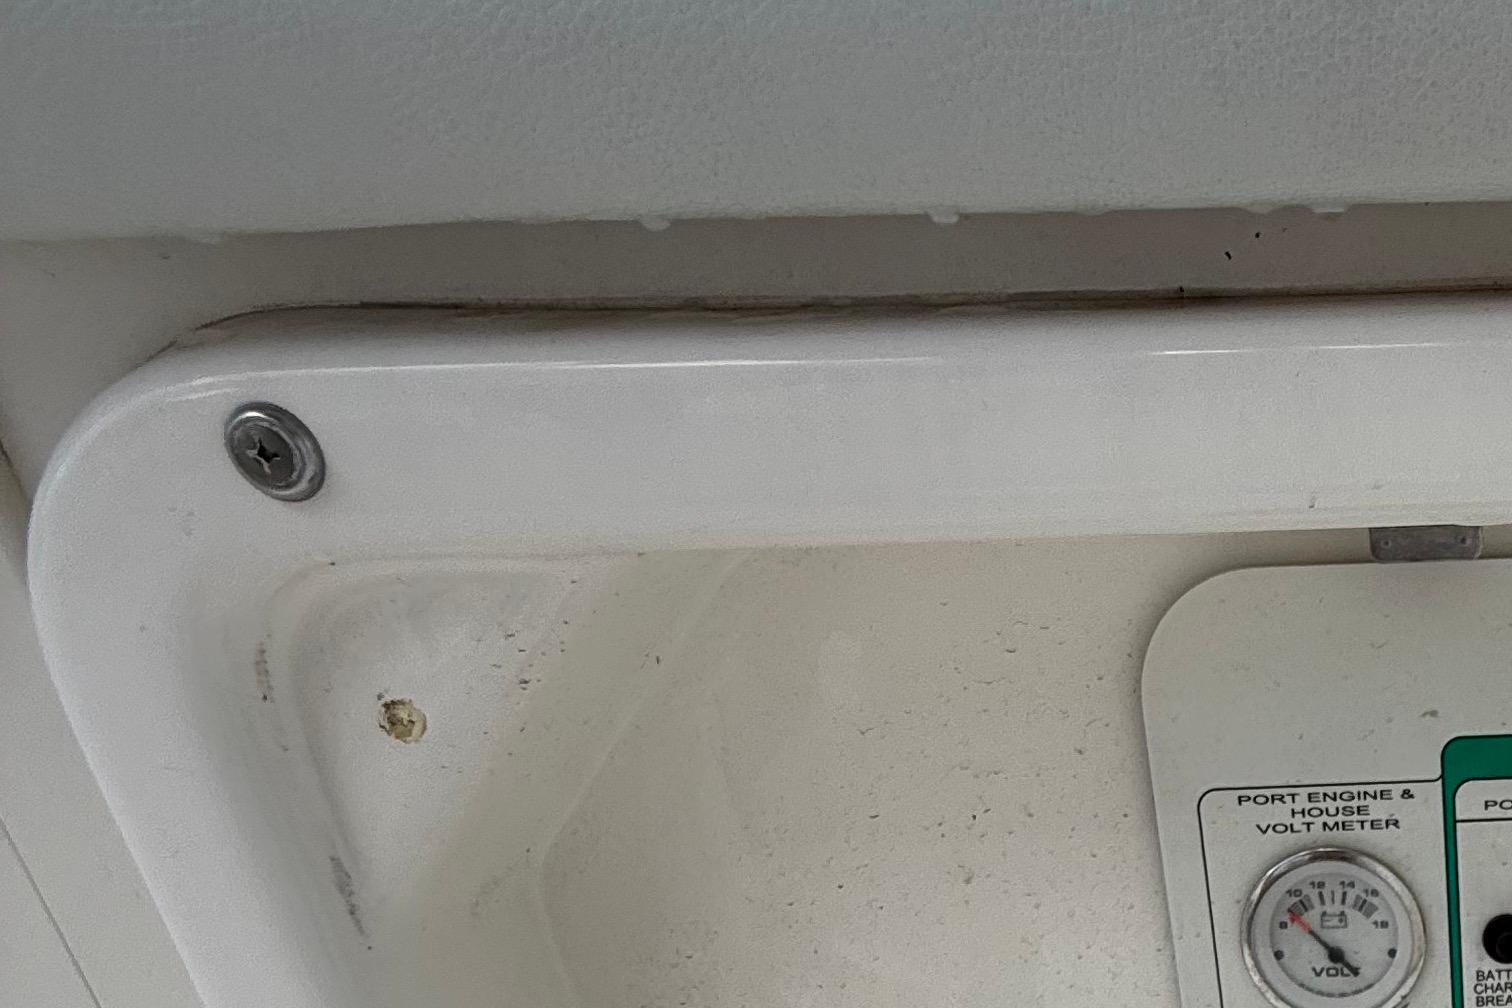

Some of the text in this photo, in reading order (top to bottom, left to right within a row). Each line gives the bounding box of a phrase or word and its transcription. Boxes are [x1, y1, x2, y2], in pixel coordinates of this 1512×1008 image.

[1238, 789, 1415, 806] PORT ENGINE &
[1291, 805, 1370, 818] HOUSE
[1256, 819, 1400, 835] VOLT METER
[1339, 881, 1356, 889] 14
[1286, 889, 1302, 898] 10
